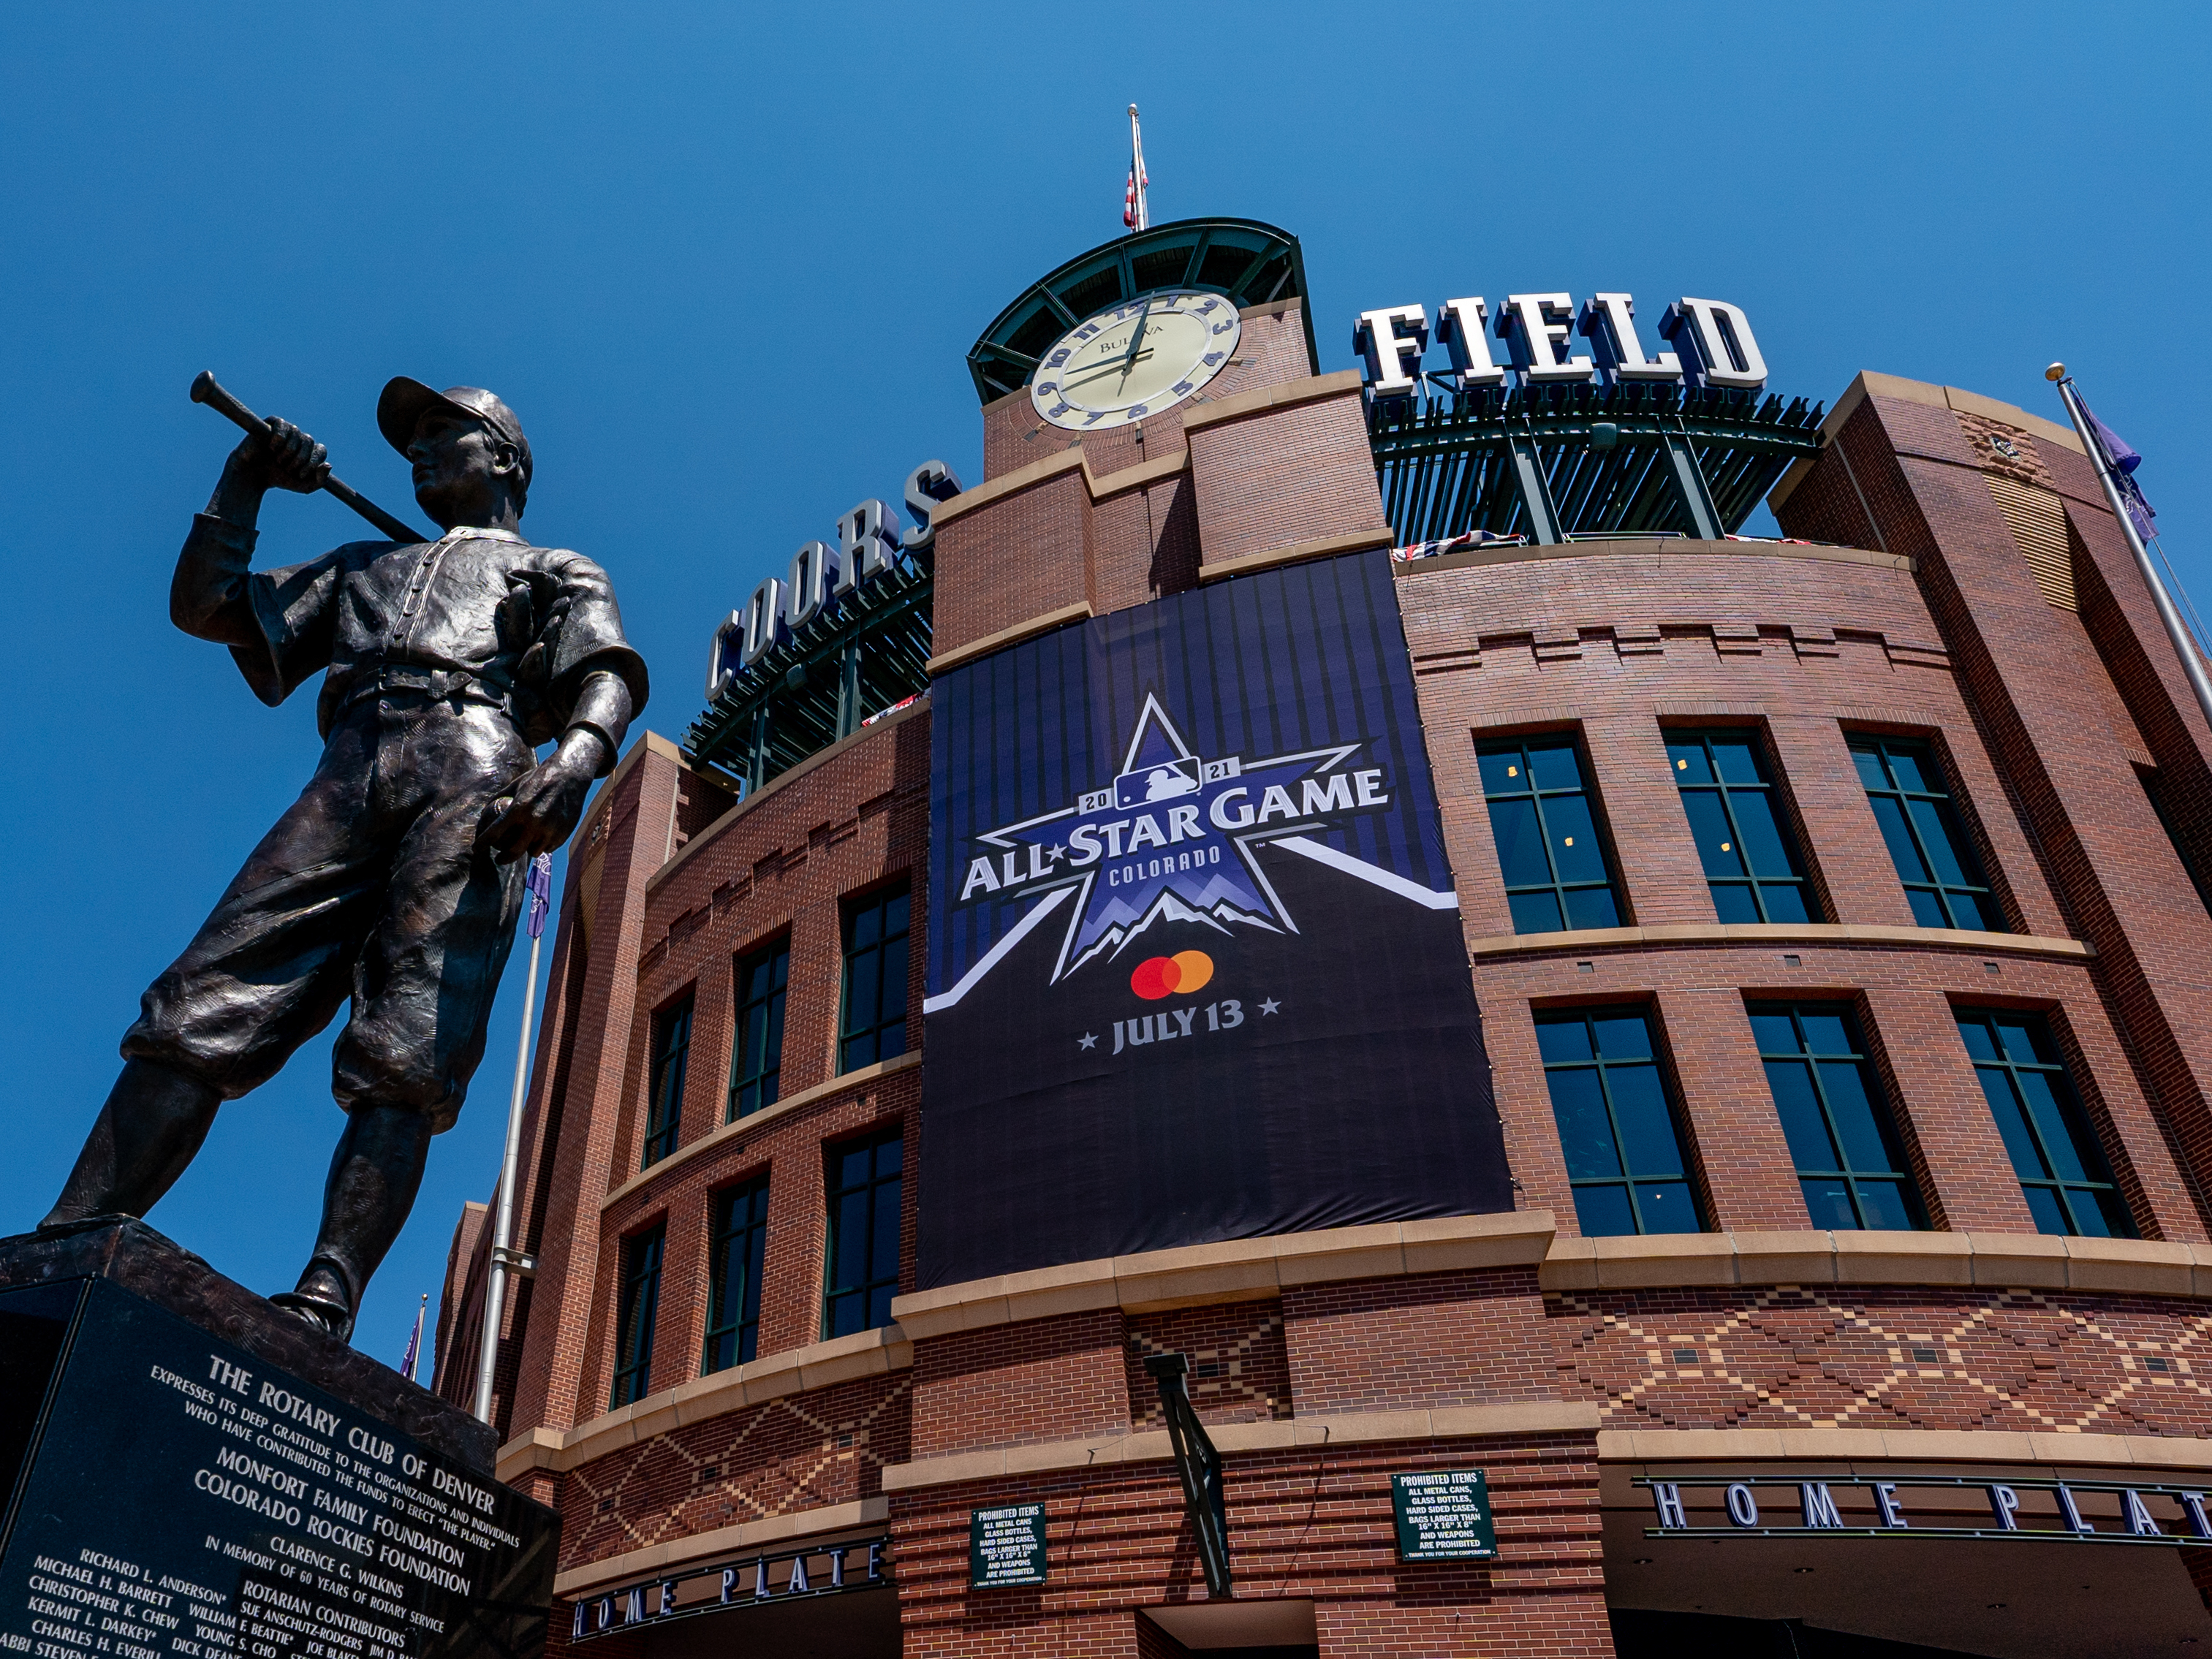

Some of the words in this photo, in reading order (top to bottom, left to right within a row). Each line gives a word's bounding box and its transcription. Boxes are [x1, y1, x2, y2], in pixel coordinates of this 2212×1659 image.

[1196, 300, 1219, 315] 2
[1074, 322, 1102, 340] 11
[1213, 319, 1233, 335] 3
[1099, 325, 1164, 354] BULVA
[1357, 292, 1768, 395] FIELD
[1045, 348, 1072, 370] 10
[1202, 351, 1224, 366] 4
[1037, 381, 1058, 396] 9
[1172, 380, 1193, 396] 5
[1048, 402, 1070, 418] 8
[1082, 411, 1105, 426] 7
[1128, 403, 1148, 419] 6
[705, 459, 962, 702] COORS
[1086, 793, 1107, 810] 20
[1210, 762, 1230, 779] 21
[961, 844, 1053, 902] ALL
[1069, 805, 1206, 867] STAR
[1210, 768, 1389, 830] GAME
[1109, 846, 1220, 887] COLORADO
[1112, 1006, 1197, 1055] JULY
[1204, 999, 1244, 1032] 13
[211, 1355, 252, 1396] THE
[260, 1381, 341, 1437] ROTARY
[349, 1427, 395, 1464] CLUB
[402, 1454, 427, 1480] OF
[433, 1468, 495, 1515] DENVER
[151, 1365, 215, 1404] EXPRESSES
[219, 1398, 237, 1415] ITS
[240, 1408, 268, 1430] DEEP
[273, 1423, 331, 1459] GRATITUDE
[336, 1452, 349, 1467] TO
[353, 1459, 371, 1478] THE
[375, 1471, 447, 1514] ORGANIZATIONS
[450, 1506, 469, 1524] AND
[471, 1516, 520, 1548] INDIVIDUALS
[185, 1400, 217, 1425] WHO
[221, 1417, 253, 1443] HAVE
[257, 1434, 330, 1478] CONTRIBUTED
[335, 1470, 353, 1487] THE
[357, 1479, 387, 1503] FUNDS
[392, 1495, 404, 1510] TO
[408, 1503, 435, 1525] ERECT
[1401, 1474, 1450, 1487] PROHIBITED
[1451, 1473, 1477, 1484] ITEMS
[1409, 1488, 1423, 1496] ALL
[1424, 1487, 1449, 1495] METAL
[1412, 1497, 1436, 1505] GLASS
[1437, 1495, 1472, 1503] BOTTLES,
[216, 1446, 308, 1500] MONFORT
[314, 1488, 368, 1525] FAMILY
[374, 1515, 465, 1568] FOUNDATION
[979, 1508, 1017, 1522] PROHIBITED
[1019, 1506, 1039, 1516] ITEMS
[1428, 1506, 1450, 1514] SIDED
[1452, 1504, 1478, 1512] CASES,
[1653, 1482, 1908, 1529] HOME
[983, 1522, 994, 1530] ALL
[996, 1519, 1015, 1528] METAL
[1409, 1516, 1428, 1524] BAGS
[1430, 1514, 1459, 1523] LARGER
[1460, 1513, 1481, 1521] THAN
[194, 1469, 300, 1526] COLORADO
[307, 1514, 374, 1557] ROCKIES
[379, 1545, 471, 1596] FOUNDATION
[985, 1530, 1004, 1538] GLASS
[997, 1537, 1014, 1545] SIDED
[1420, 1532, 1436, 1540] AND
[1437, 1530, 1474, 1539] WEAPONS
[998, 1545, 1020, 1554] LARGER
[1419, 1541, 1434, 1549] ARE
[1436, 1539, 1481, 1549] PROHIBITED
[80, 1548, 139, 1578] RICHARD
[143, 1570, 154, 1583] L.
[270, 1536, 335, 1572] CLARENCE
[340, 1563, 352, 1579] G.
[358, 1569, 404, 1598] WILKINS
[986, 1571, 998, 1579] ARE
[999, 1568, 1034, 1577] PROHIBITED
[1001, 1559, 1031, 1568] WEAPONS
[34, 1555, 94, 1584] MICHAEL
[99, 1577, 113, 1591] H.
[118, 1582, 173, 1608] BARRETT
[205, 1536, 220, 1551] IN
[223, 1542, 276, 1571] MEMORY
[280, 1563, 296, 1578] OF
[299, 1571, 312, 1584] 60
[317, 1576, 349, 1598] YEARS
[353, 1590, 367, 1604] OF
[370, 1597, 407, 1619] ROTARY
[409, 1611, 444, 1633] SERVICE
[572, 1582, 675, 1638] HOME
[720, 1543, 882, 1604] PLATE
[28, 1595, 81, 1622] KERMIT
[85, 1612, 95, 1627] L.
[29, 1575, 119, 1612] CHRISTOPHER
[124, 1603, 136, 1618] K.
[142, 1609, 180, 1630] CHEW
[189, 1603, 237, 1629] WILLIAM
[240, 1620, 248, 1632] F.
[243, 1580, 312, 1617] ROTARIAN
[316, 1606, 406, 1648] CONTRIBUTORS
[31, 1620, 94, 1646] CHARLES
[96, 1636, 110, 1652] H.
[240, 1601, 260, 1617] SUE
[263, 1609, 363, 1652] ANSCHUTZ-RODGERS
[172, 1637, 202, 1656] DICK
[196, 1624, 235, 1647] YOUNG
[238, 1638, 246, 1650] S.
[251, 1642, 276, 1658] CHO
[306, 1641, 325, 1656] JOE
[369, 1644, 385, 1659] JIM
